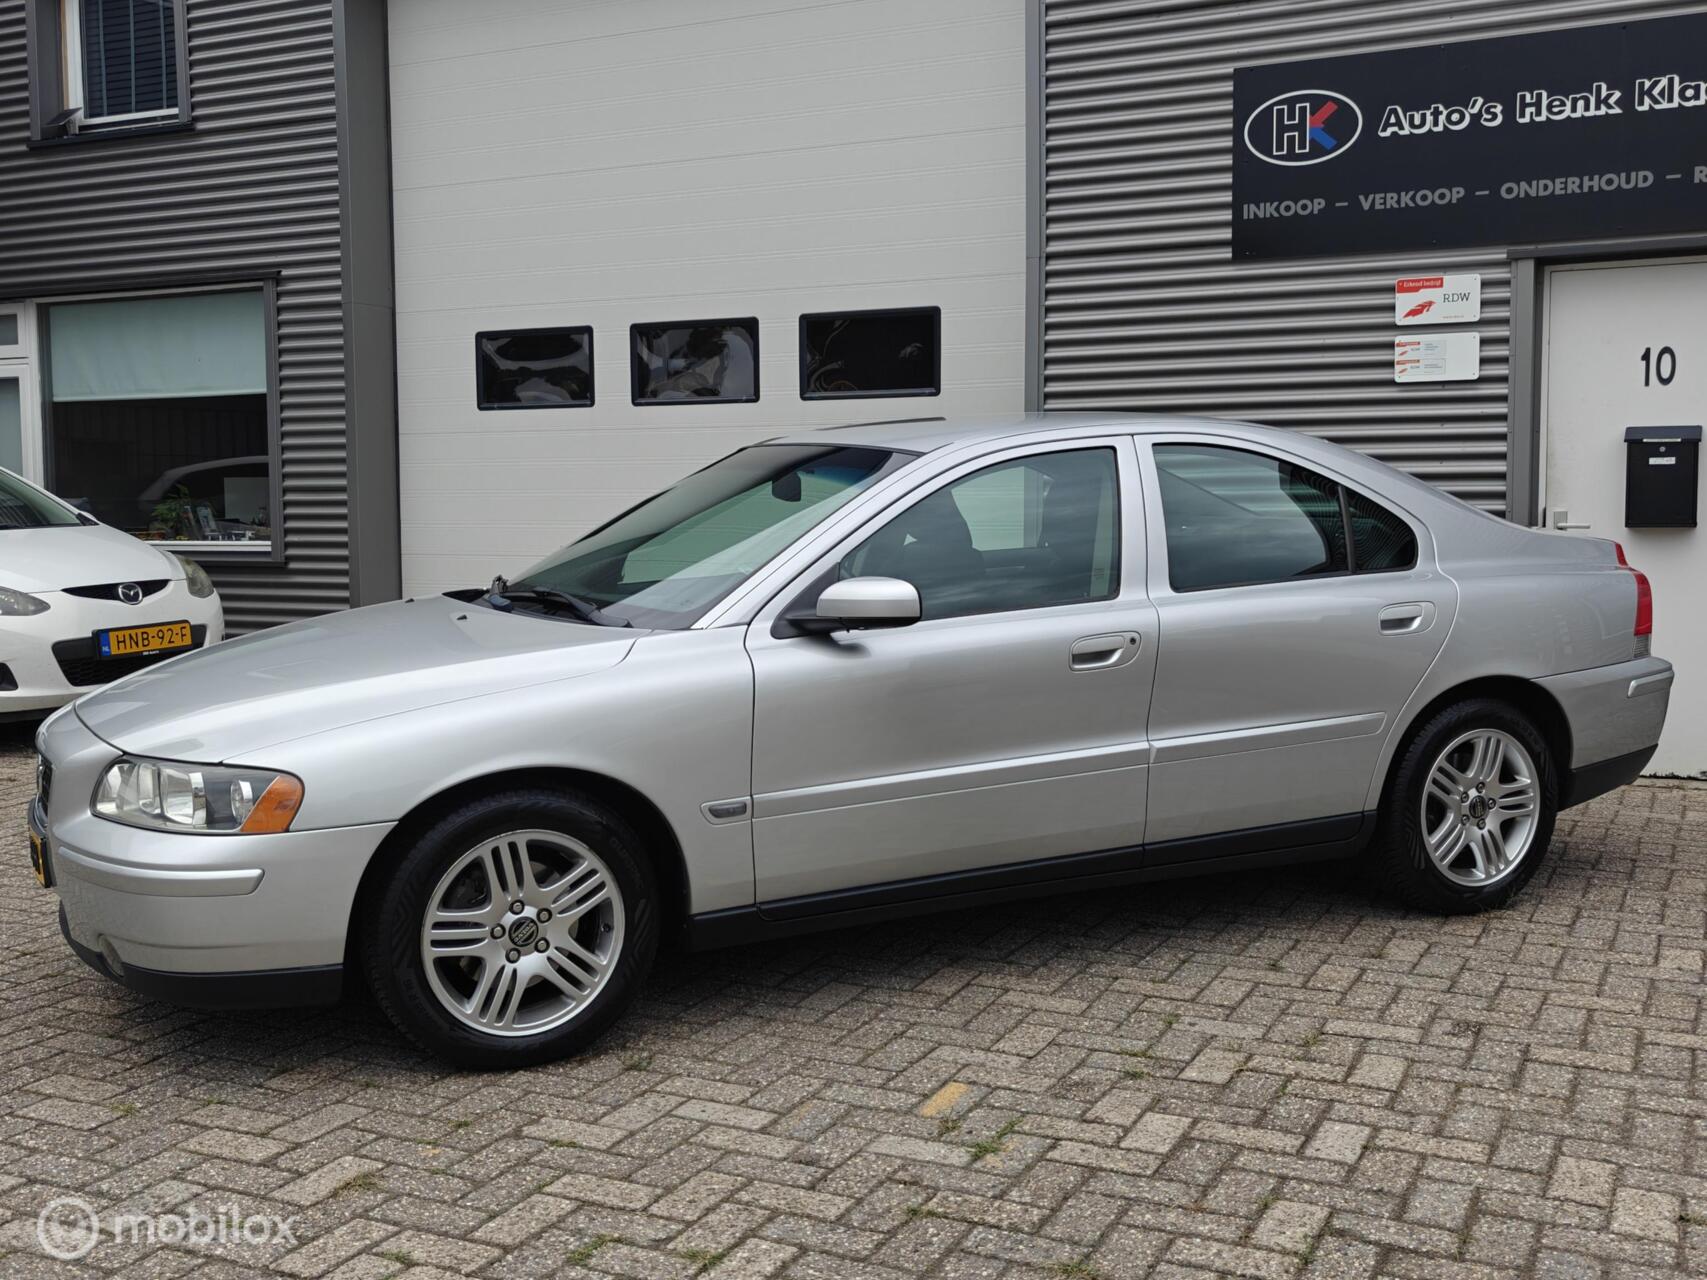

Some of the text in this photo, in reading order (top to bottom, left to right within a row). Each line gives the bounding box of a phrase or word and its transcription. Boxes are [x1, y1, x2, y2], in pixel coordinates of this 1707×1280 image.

[1378, 74, 1707, 137] Auto's Henk Kla
[1243, 198, 1326, 220] INKOOP
[1359, 187, 1466, 211] VERKOOP
[1500, 170, 1654, 199] ONDERHOUD
[1443, 292, 1471, 303] RDW
[1641, 346, 1676, 387] 10
[116, 626, 187, 650] HNB-92-F
